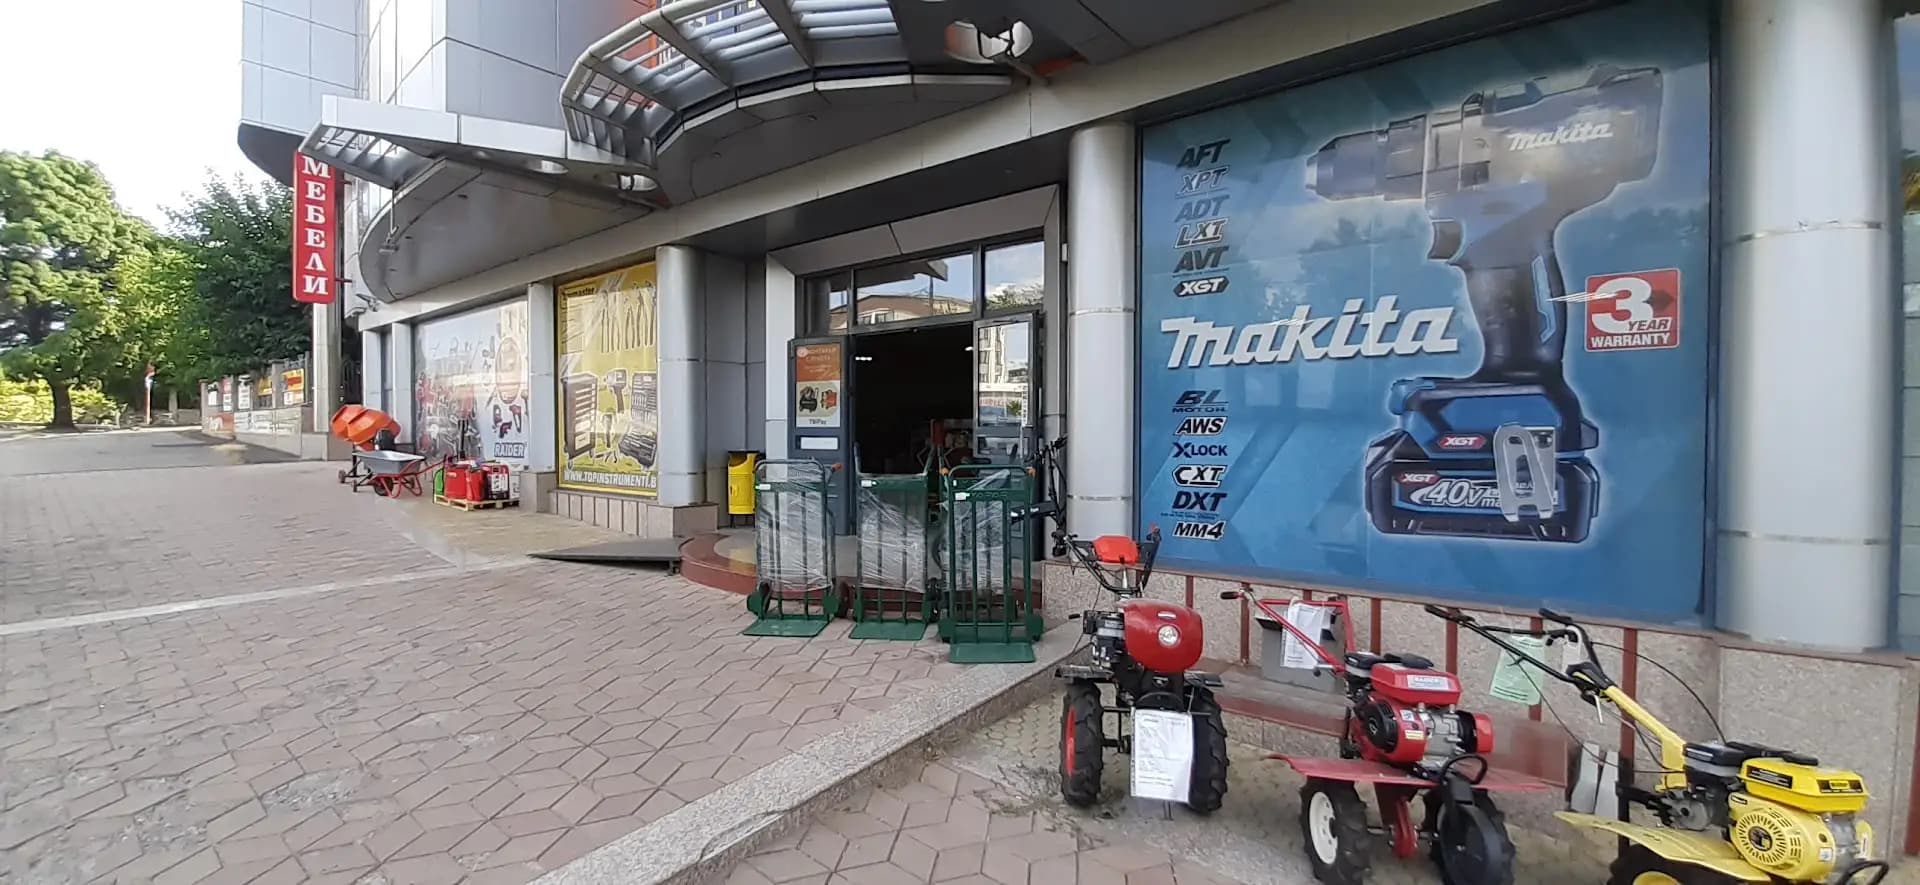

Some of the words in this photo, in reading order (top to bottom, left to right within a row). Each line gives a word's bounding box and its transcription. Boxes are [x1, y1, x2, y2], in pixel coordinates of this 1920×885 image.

[1176, 138, 1231, 168] AFT
[1178, 166, 1230, 194] XPT
[1174, 194, 1230, 223] ADT
[301, 154, 331, 296] МЕБЕЛИ
[1174, 218, 1229, 248] LXT
[1172, 246, 1230, 273] AVT
[1179, 277, 1225, 296] XGT
[1591, 277, 1654, 334] 3
[1628, 319, 1671, 331] YEAR
[1591, 332, 1670, 348] WARRANTY
[1175, 389, 1229, 405] BL
[1176, 418, 1224, 434] AWS
[494, 442, 525, 458] RAIDER
[1445, 436, 1478, 446] XGT
[1174, 466, 1225, 485] CXT
[1402, 473, 1436, 483] XGT
[1172, 490, 1228, 511] DXT
[1480, 497, 1502, 508] ma
[1174, 520, 1225, 539] MM4
